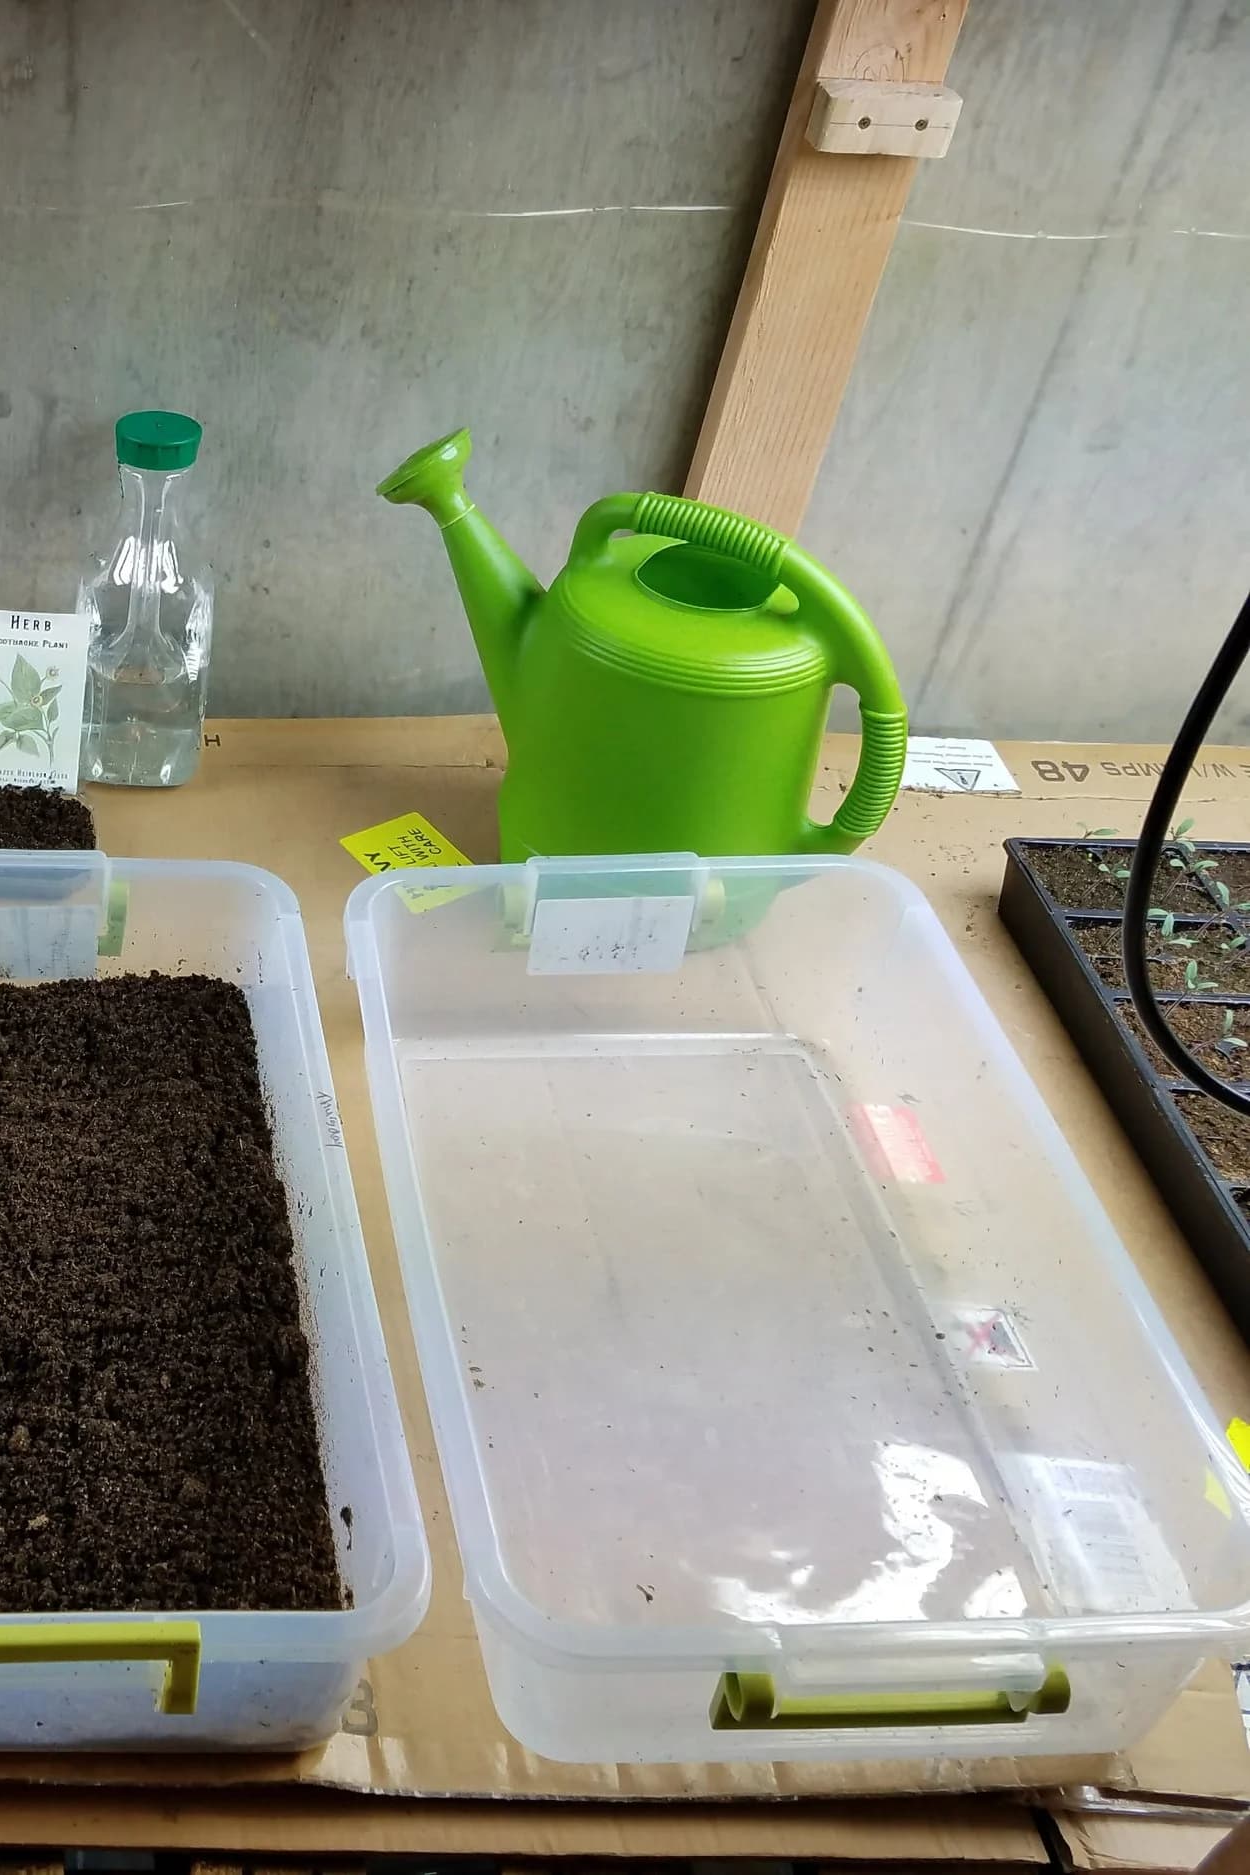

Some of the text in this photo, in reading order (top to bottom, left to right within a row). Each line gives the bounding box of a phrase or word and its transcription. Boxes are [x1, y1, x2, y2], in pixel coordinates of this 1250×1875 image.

[11, 614, 52, 632] HERB
[397, 835, 429, 861] WITH
[407, 828, 442, 854] CARE
[387, 845, 416, 865] LIFT
